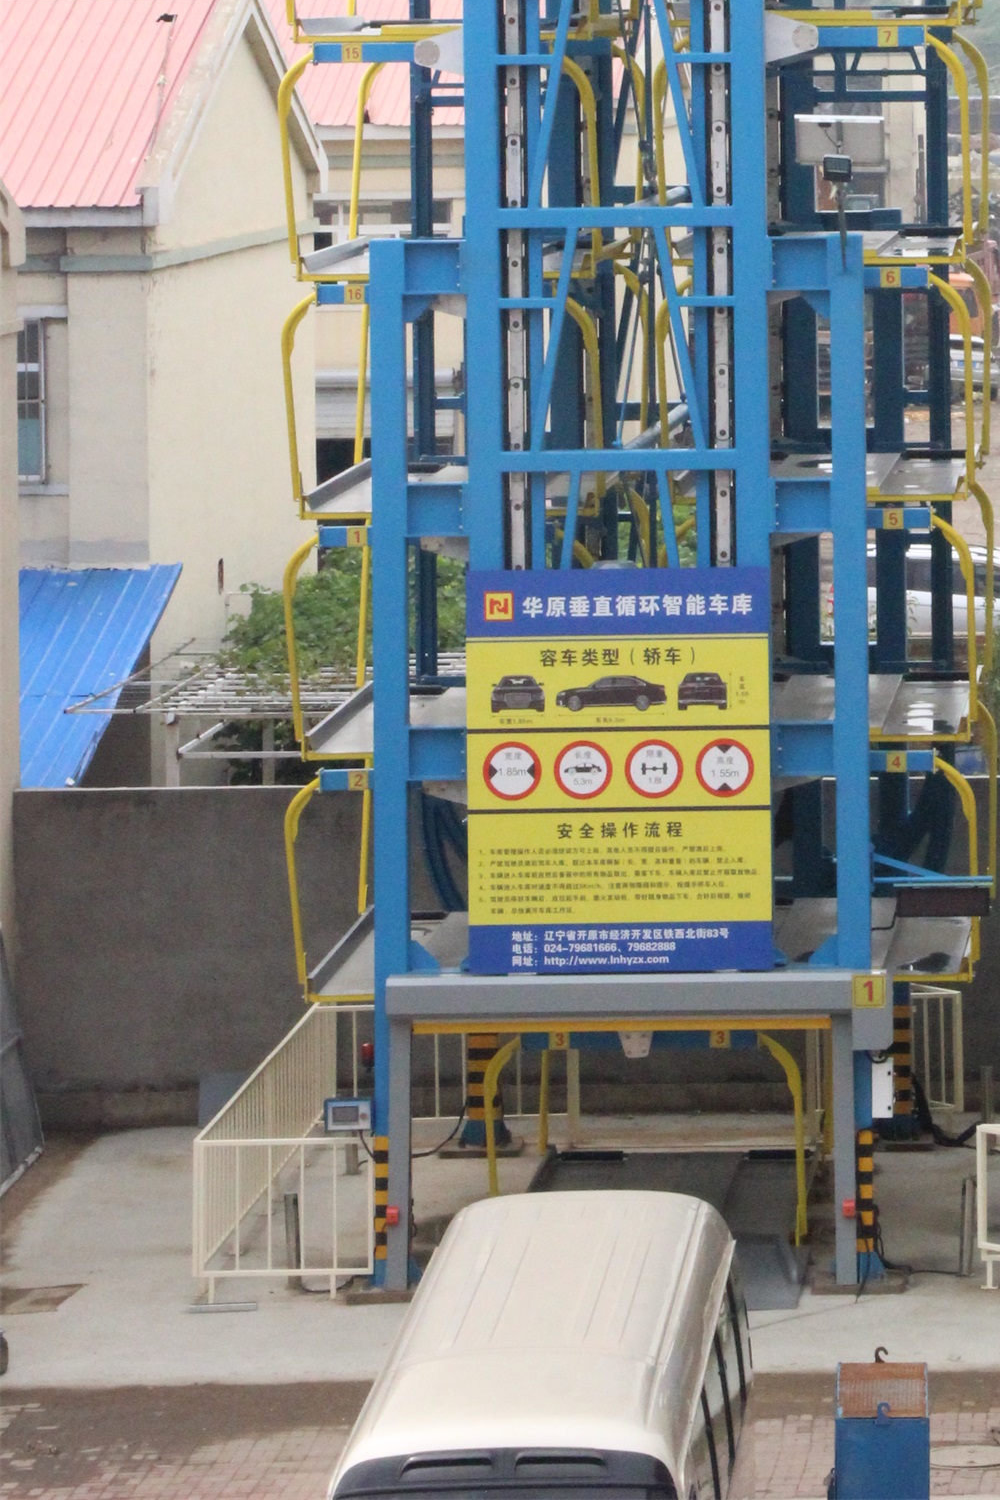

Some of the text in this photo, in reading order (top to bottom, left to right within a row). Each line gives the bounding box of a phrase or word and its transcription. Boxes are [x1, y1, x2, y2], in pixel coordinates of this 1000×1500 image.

[882, 30, 892, 44] 7
[345, 46, 359, 61] 15
[885, 270, 896, 285] 6
[348, 287, 361, 301] 16
[888, 512, 898, 527] 5
[353, 529, 361, 544] 1
[522, 593, 753, 618] 华原垂直循环智能车库
[540, 646, 696, 667] 容车类型（轿车）
[574, 750, 591, 759] 长度
[716, 756, 734, 765] 高度
[891, 755, 901, 770] 4
[498, 767, 527, 777] 1.85m
[711, 769, 740, 778] 1.55m
[354, 773, 364, 787] 2
[573, 778, 593, 786] 5.3m
[556, 822, 684, 838] 安全操作流程
[863, 979, 873, 1002] 1
[555, 1032, 565, 1046] 3
[716, 1030, 725, 1044] 3
